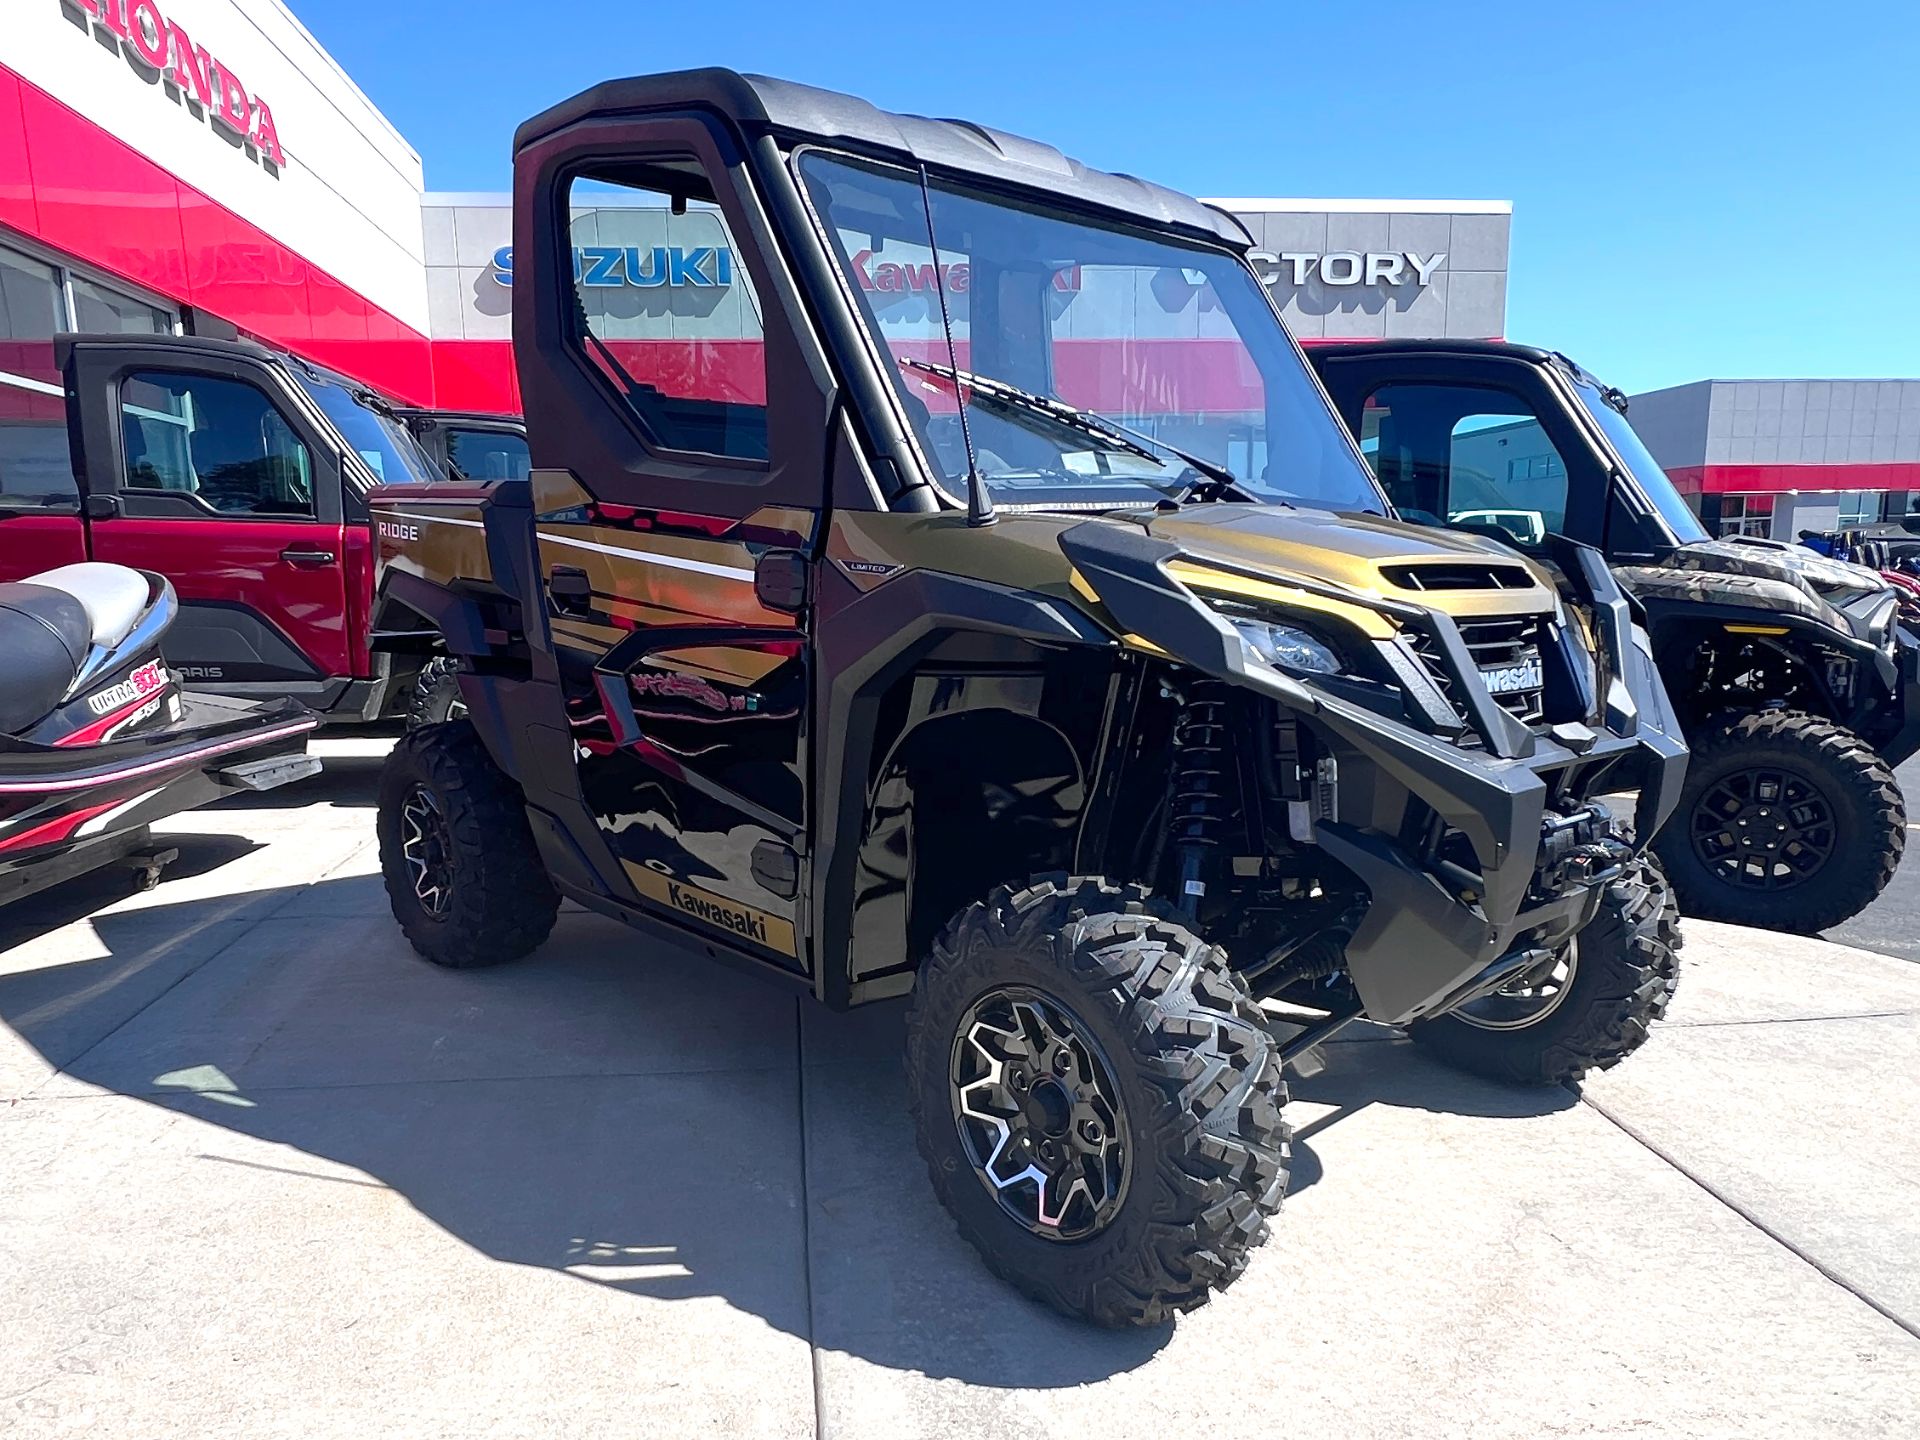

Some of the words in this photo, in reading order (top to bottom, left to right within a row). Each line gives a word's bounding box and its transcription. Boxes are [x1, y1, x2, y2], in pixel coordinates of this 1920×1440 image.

[379, 522, 418, 541] RIDGE
[851, 563, 886, 573] LIMITED
[177, 667, 223, 678] ARIS
[1479, 658, 1543, 693] wasaki
[91, 683, 135, 712] ULTRA
[132, 664, 161, 693] 300
[668, 882, 767, 942] Kawasaki
